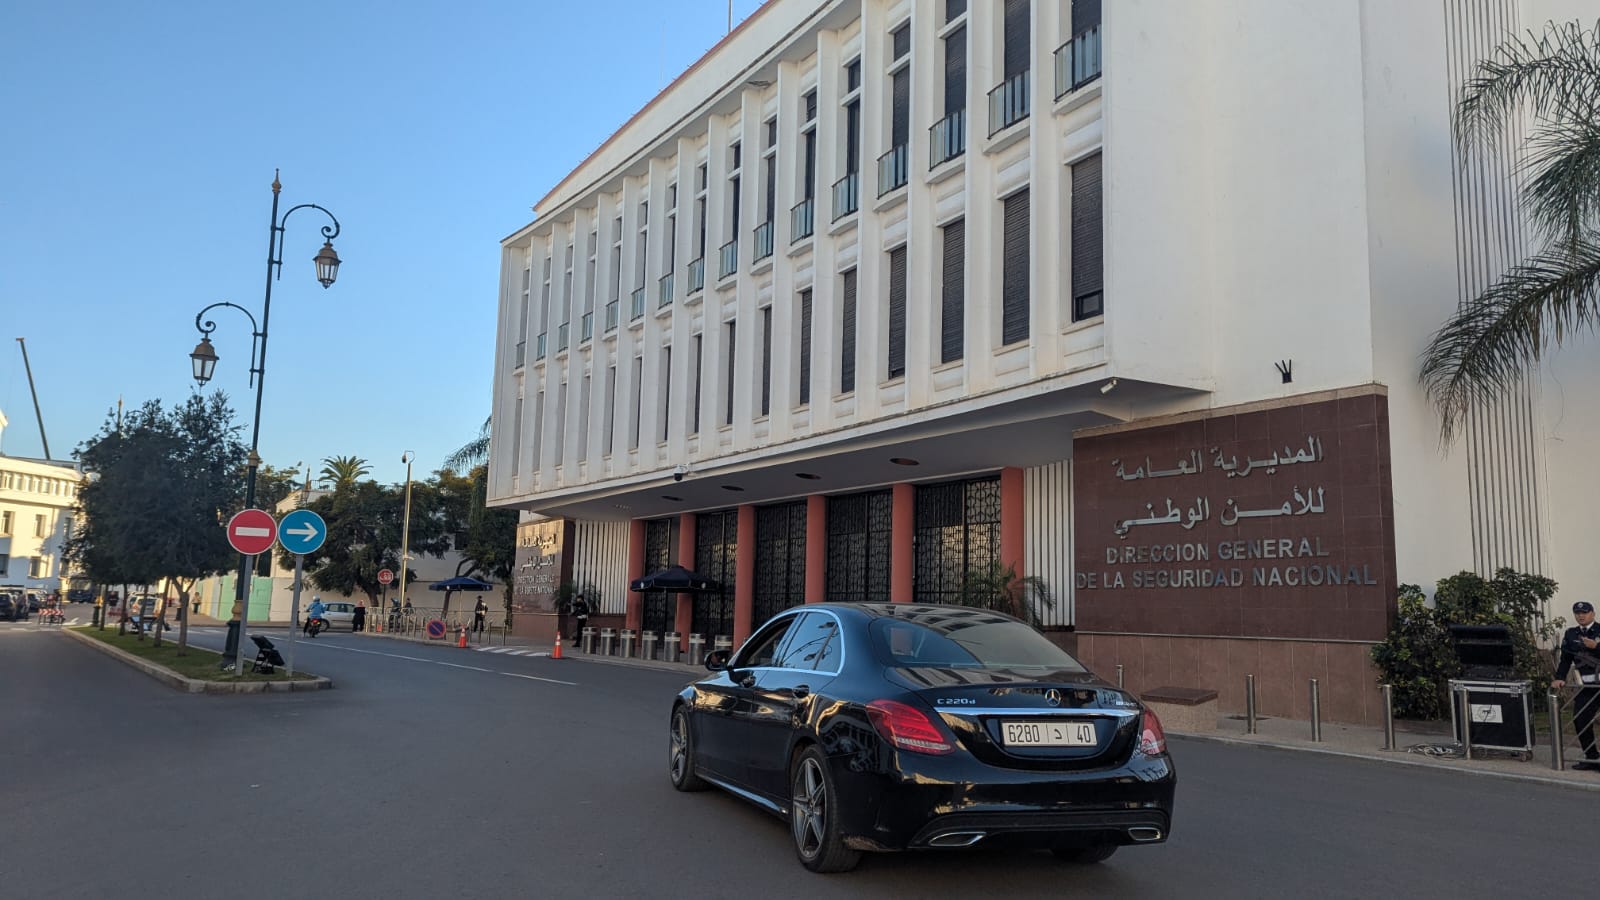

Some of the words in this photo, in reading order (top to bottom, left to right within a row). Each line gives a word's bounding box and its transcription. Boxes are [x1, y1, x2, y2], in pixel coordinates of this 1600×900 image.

[1112, 449, 1204, 481] العامة
[1210, 434, 1324, 478] المديرية
[1113, 495, 1210, 540] الوطني
[1220, 485, 1326, 526] للأمن
[1106, 543, 1209, 564] DIRECCION
[1217, 536, 1330, 560] GENERAL
[1076, 572, 1097, 589] DE
[1103, 571, 1125, 589] LA
[1132, 567, 1245, 589] SEGURIDAD
[1252, 564, 1378, 587] NACIONAL
[1008, 724, 1041, 743] 6280
[1076, 725, 1091, 743] 40
